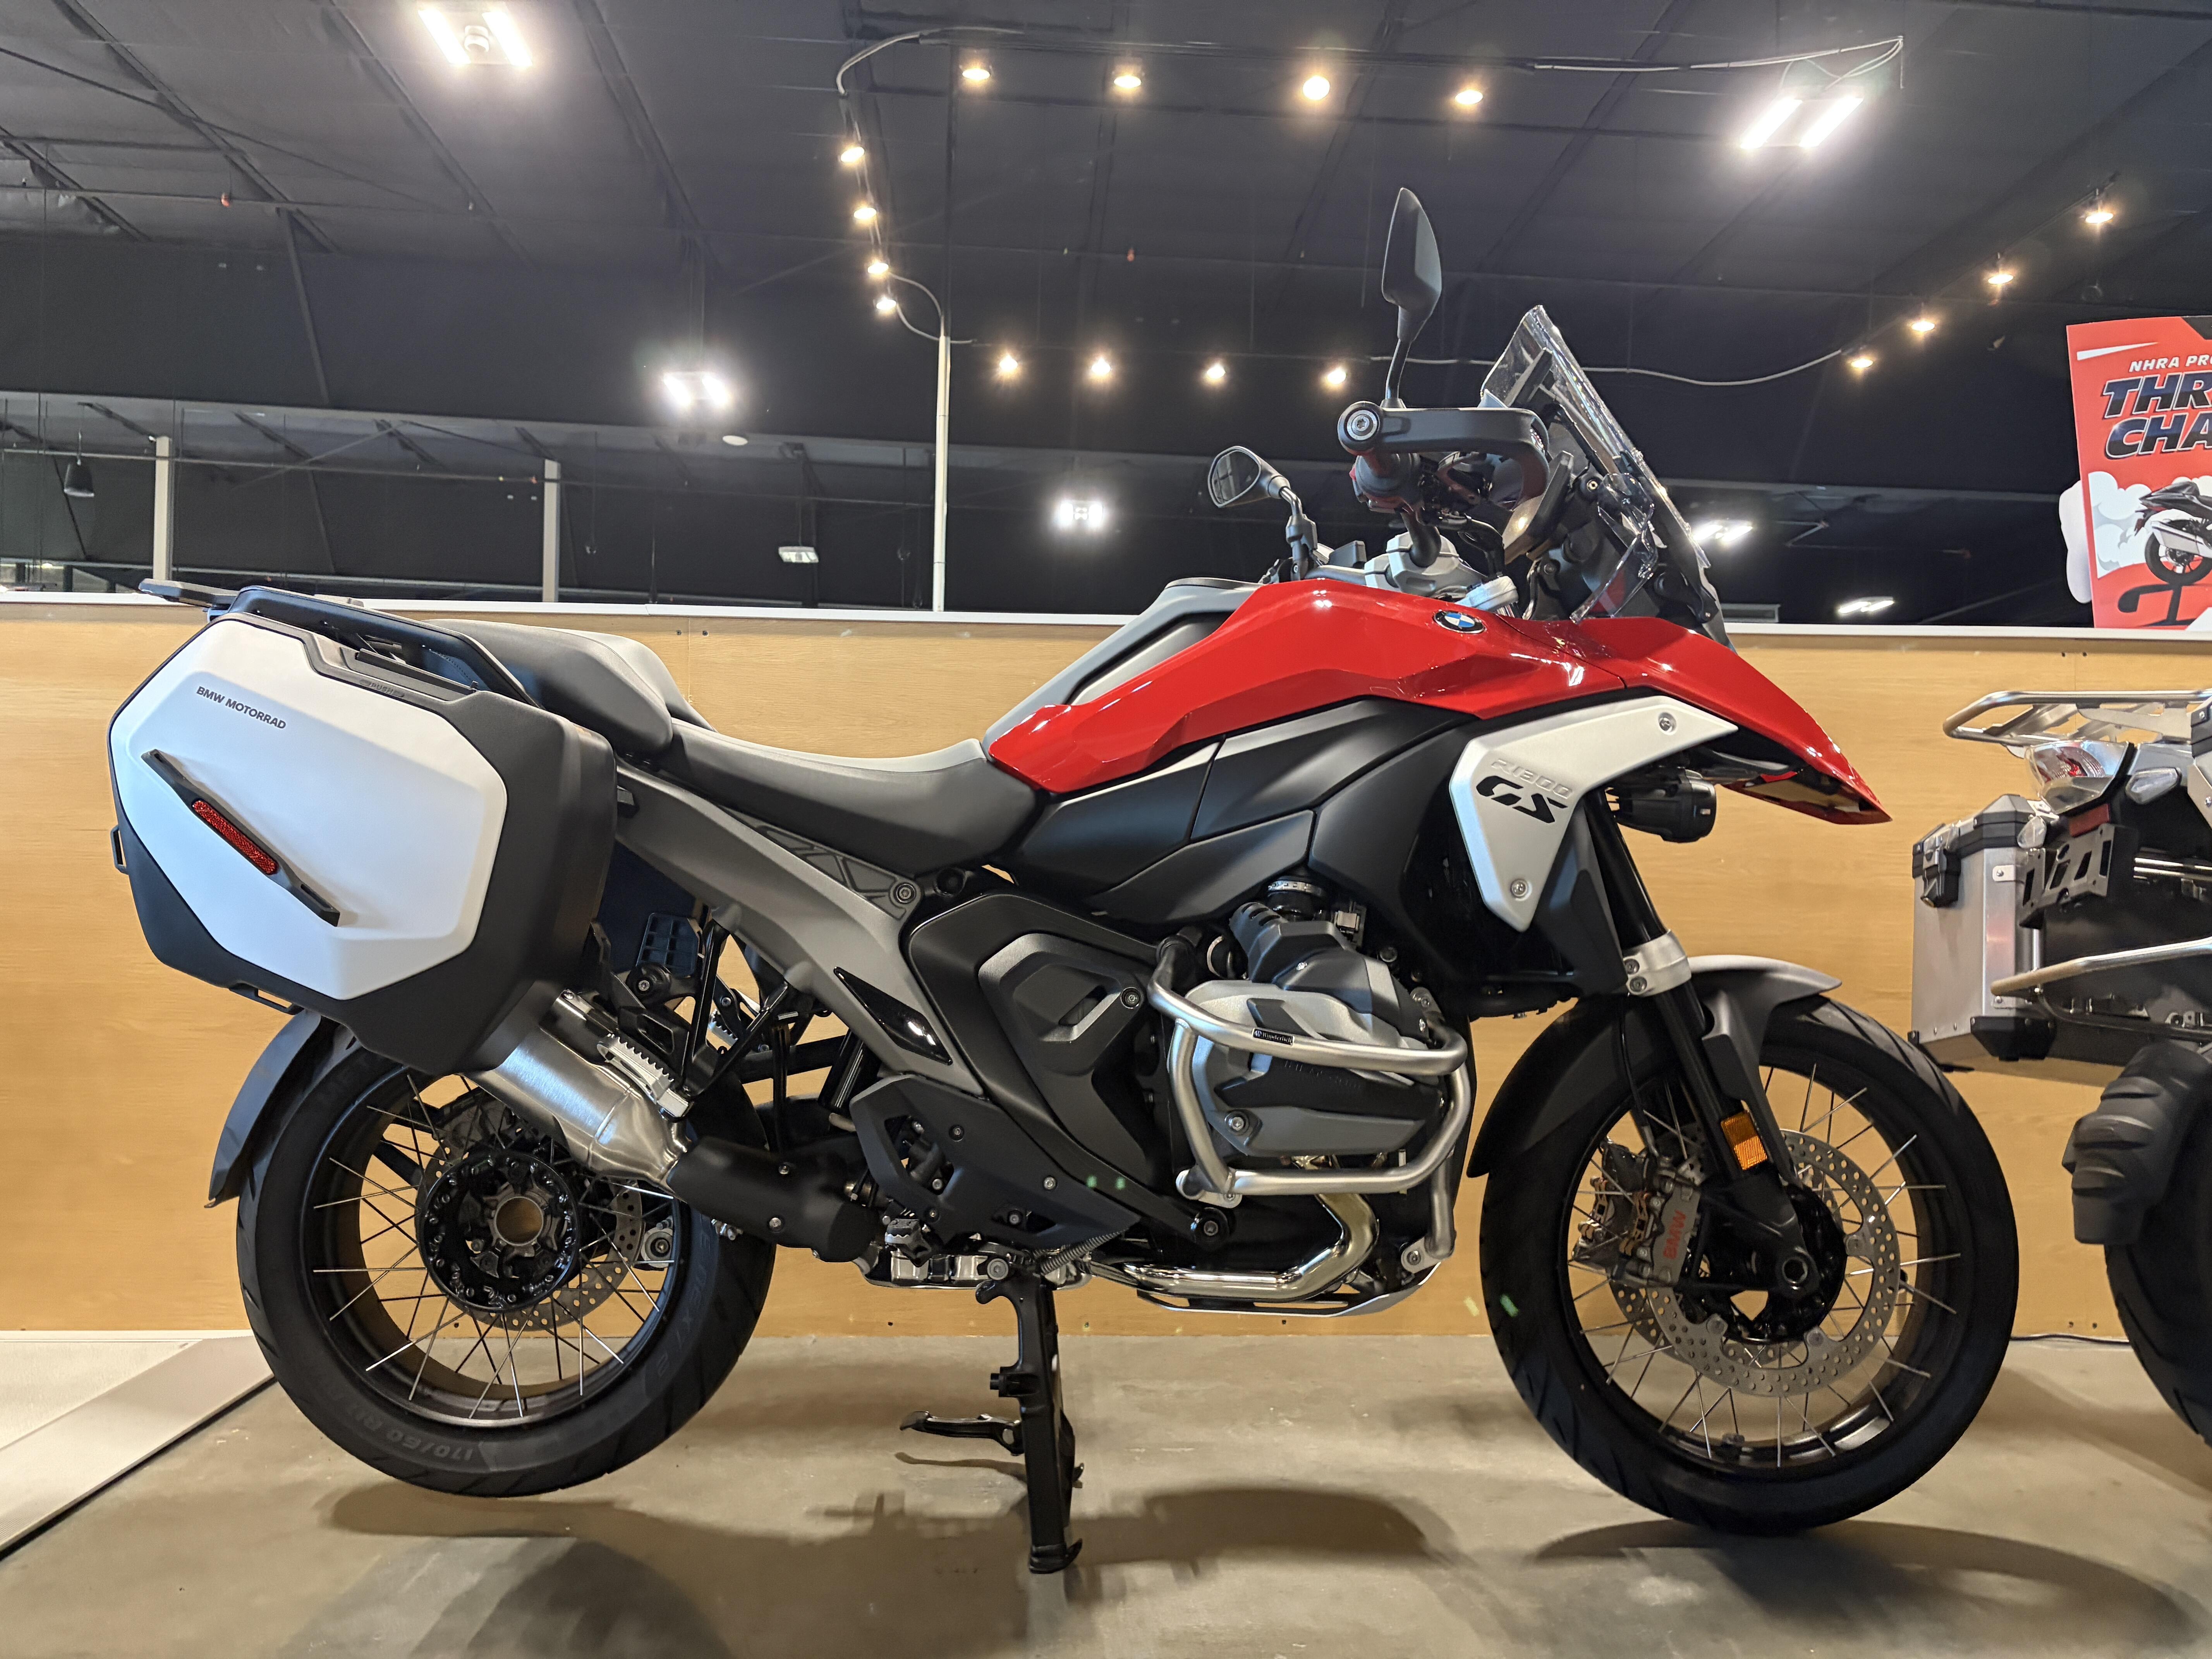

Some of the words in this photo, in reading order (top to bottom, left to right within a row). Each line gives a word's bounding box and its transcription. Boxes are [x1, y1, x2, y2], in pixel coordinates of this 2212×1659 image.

[2129, 356, 2179, 372] NHRA
[2185, 354, 2212, 367] PR
[2105, 410, 2212, 459] CHA
[196, 686, 225, 703] BMW
[225, 699, 286, 729] MOTORRAD
[370, 682, 394, 694] PUSH
[1476, 775, 1568, 823] GS
[1663, 1209, 1687, 1259] BMW
